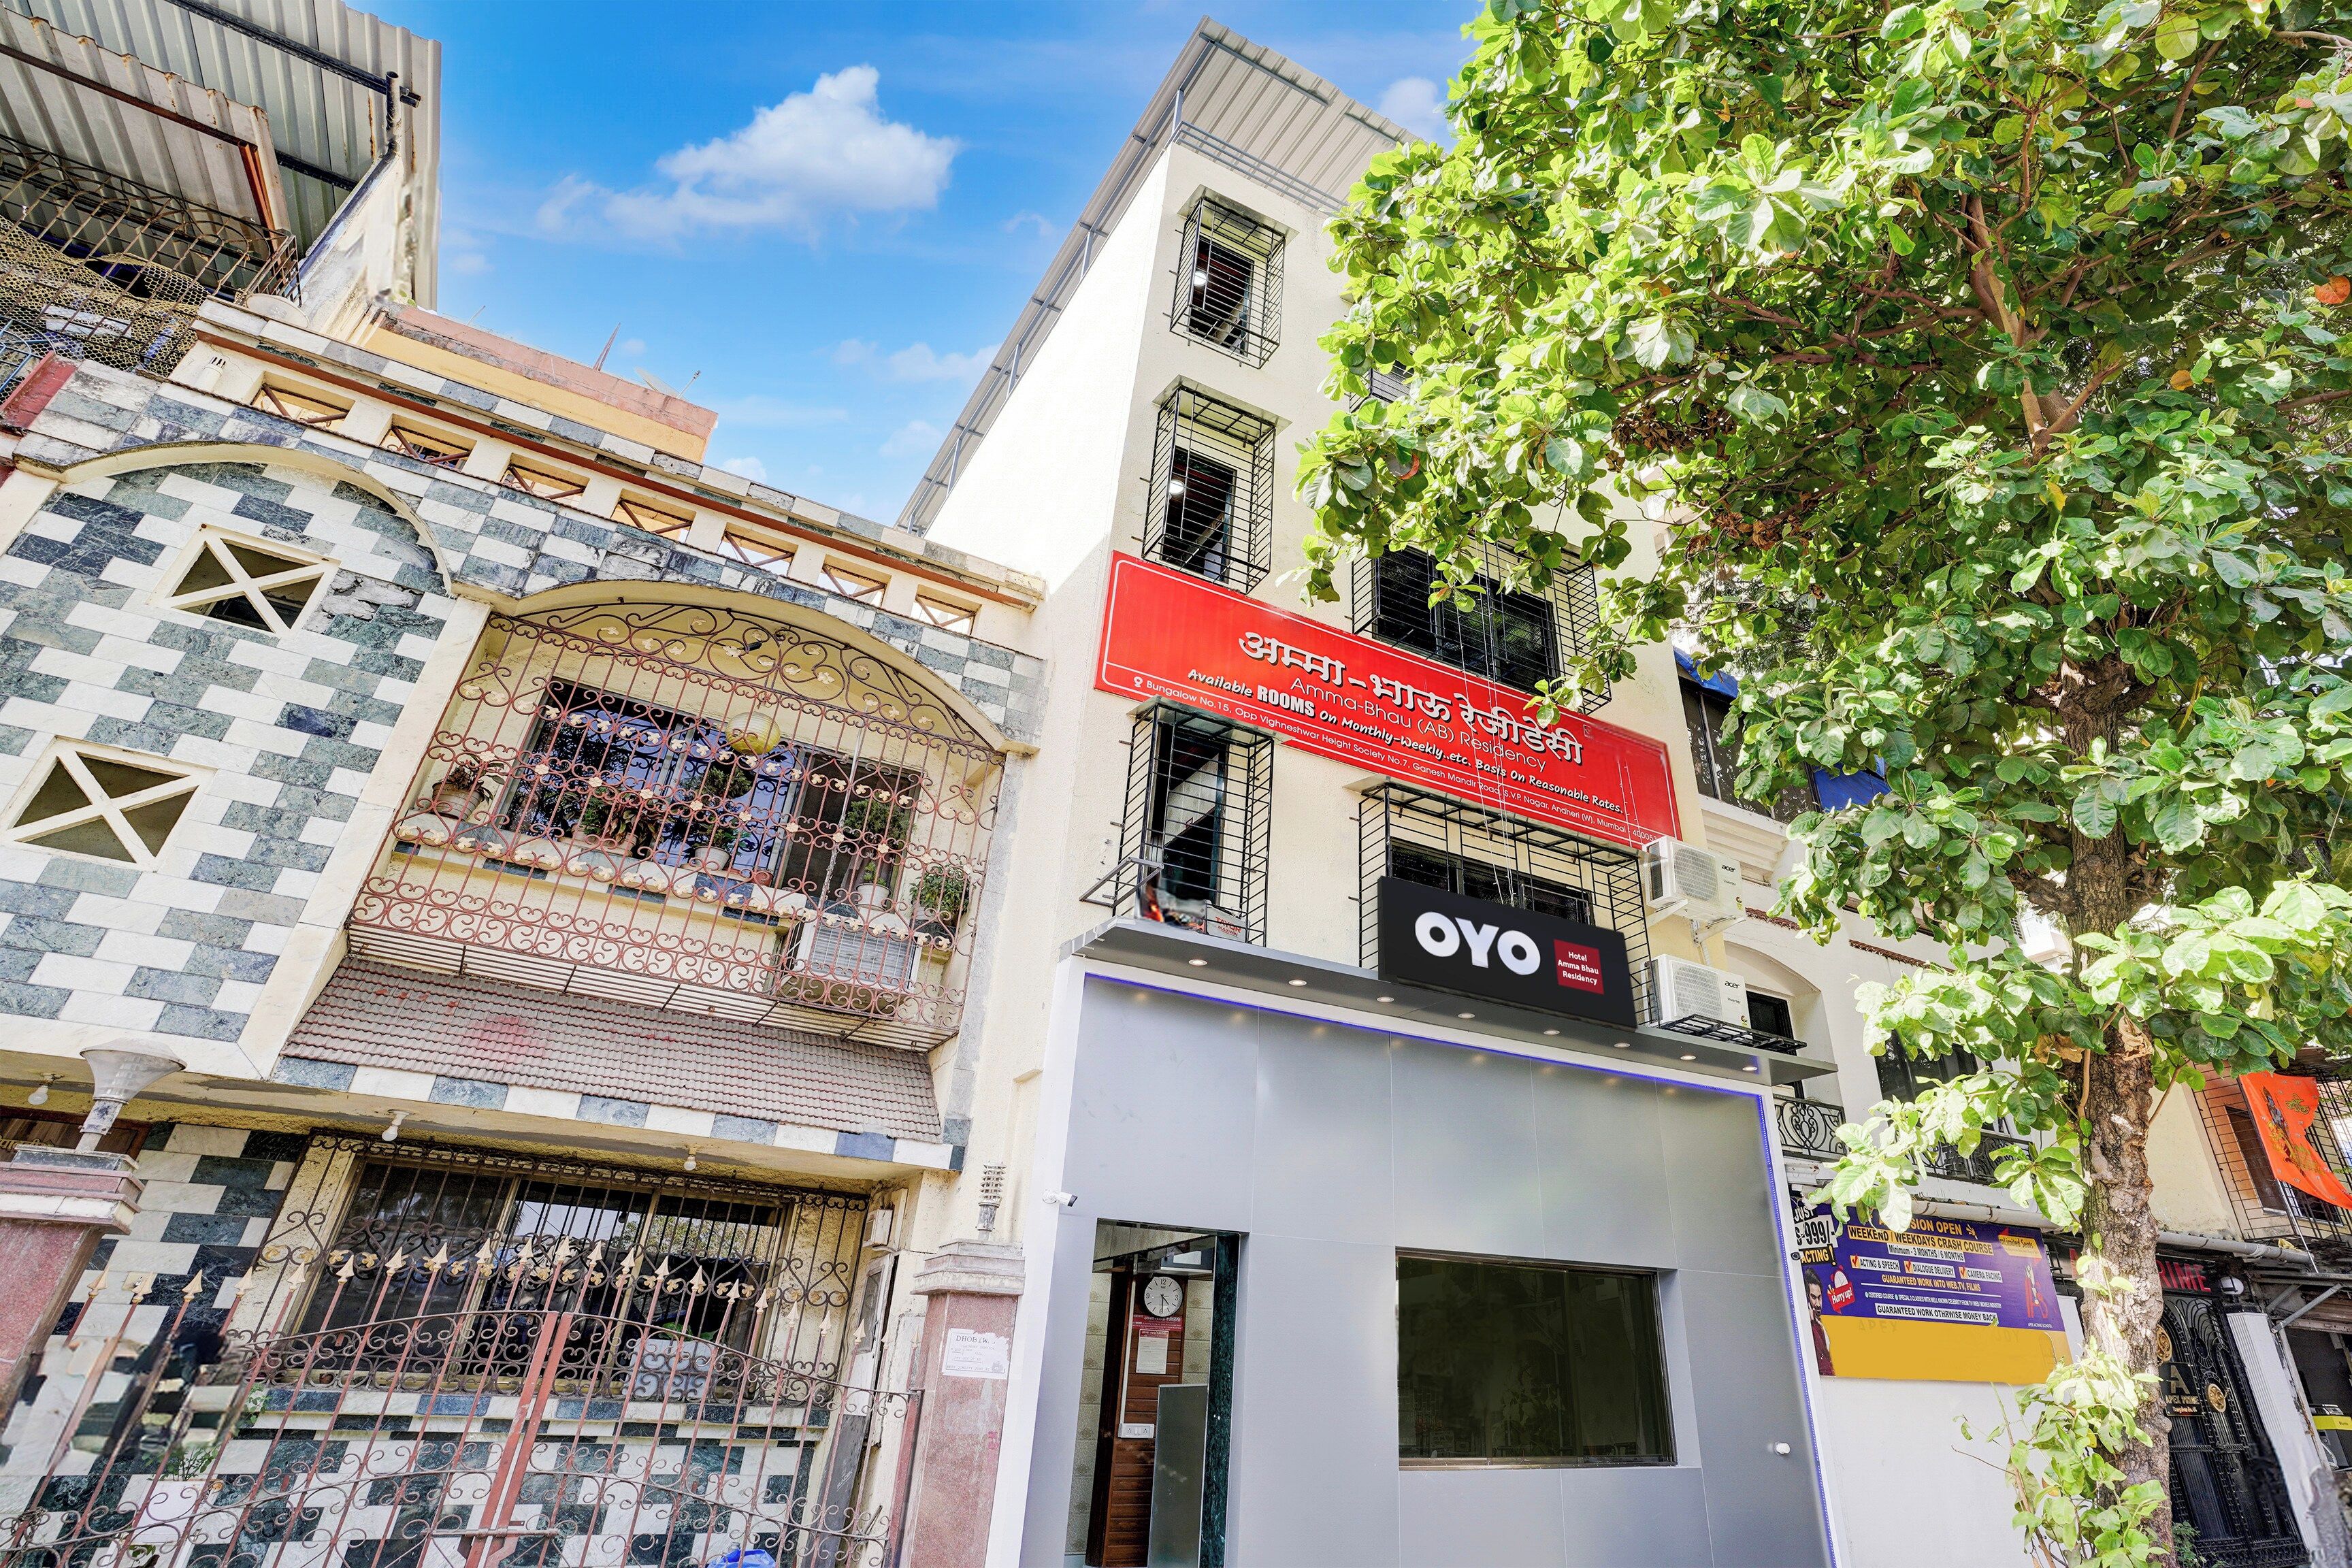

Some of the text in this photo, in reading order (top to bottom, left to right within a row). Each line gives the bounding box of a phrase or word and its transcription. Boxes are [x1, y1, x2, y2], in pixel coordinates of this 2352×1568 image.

[1290, 677, 1546, 772] Amma-Bhau (AB) Residency
[1188, 669, 1252, 697] Available
[1258, 685, 1315, 717] ROOMS
[1475, 759, 1506, 777] Basis
[1511, 770, 1525, 783] On
[1529, 774, 1589, 802] Reasonable
[1592, 795, 1623, 814] Rates.
[1147, 680, 1197, 702] Bungalow
[1200, 697, 1232, 713] No.15,
[1235, 707, 1258, 721] Opp
[1260, 715, 1320, 740] Vighneshwar
[1322, 734, 1351, 750] Height
[1353, 744, 1386, 761] Society
[1388, 754, 1411, 768] No.7,
[1413, 762, 1446, 778] Ganesh
[1448, 772, 1476, 787] Mandir
[1524, 795, 1550, 810] Nagar,
[1552, 804, 1580, 819] Andheri
[1597, 817, 1627, 833] Mumbai
[1721, 864, 1736, 872] acer
[1415, 911, 1541, 976] OYO
[1568, 951, 1588, 962] Hotel
[1558, 959, 1599, 975] Amma Bhau
[1562, 970, 1597, 986] Residency
[1725, 981, 1740, 989] acer
[1936, 1222, 1963, 1235] OPEN
[1848, 1226, 1889, 1241] WEEKEND
[1895, 1232, 1936, 1248] WEEKDAYS
[1938, 1239, 1963, 1251] CRASH
[1964, 1242, 1993, 1255] COURSE
[1889, 1244, 1910, 1255] Minimum
[1913, 1247, 1917, 1256] 3
[1917, 1248, 1938, 1258] MONTHS
[1940, 1250, 1944, 1258] 6
[1944, 1251, 1964, 1261] MONTHS
[1860, 1258, 1899, 1271] ACTING & SPEECH
[1912, 1264, 1954, 1276] DIALOGUE DELIVERY
[1882, 1274, 1916, 1286] GUARANTEED
[1917, 1277, 1933, 1287] WORK
[1933, 1279, 1946, 1288] INTO
[1966, 1283, 1981, 1292] FILMS
[1967, 1270, 2002, 1281] CAMERA FACING
[2156, 1260, 2211, 1292] RIME
[1831, 1292, 1846, 1305] Hurry
[1877, 1305, 1996, 1322] GUARANTEED WORK OTHRWISE MONEY BACK
